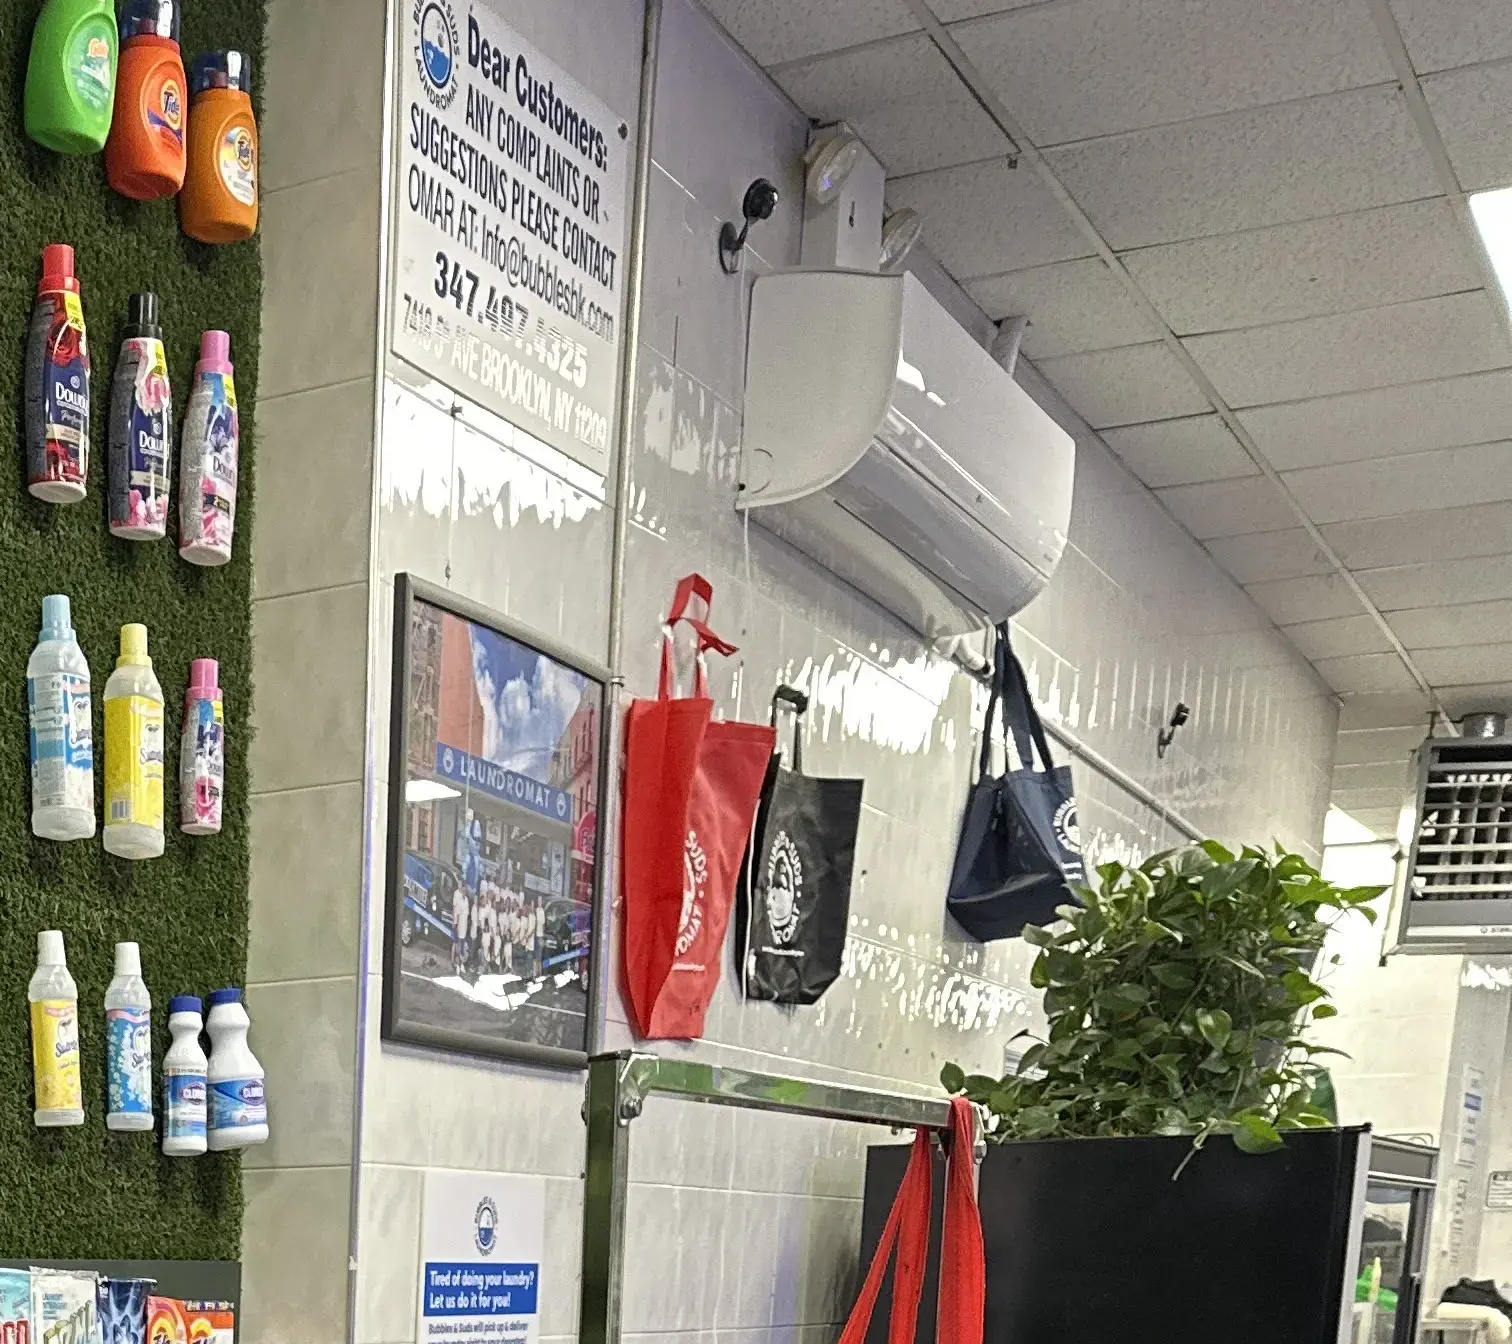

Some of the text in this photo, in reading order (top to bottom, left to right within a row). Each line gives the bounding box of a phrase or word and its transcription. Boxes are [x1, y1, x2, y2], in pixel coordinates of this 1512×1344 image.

[414, 45, 459, 110] LAUNDROMAT
[468, 13, 510, 94] Dear
[163, 90, 180, 115] Tide
[465, 83, 600, 224] ANY COMPLAINTS OR
[408, 162, 455, 238] OMAR
[457, 199, 478, 253] AT:
[410, 102, 617, 291] SUGGESTIONS PLEASE CONTACT
[554, 387, 574, 433] NY
[460, 755, 551, 809] LAUNDROMAT
[429, 1269, 535, 1291] Tired of doing your laundry?
[429, 1291, 445, 1309] Let
[445, 1295, 456, 1309] us
[457, 1292, 470, 1309] do
[470, 1292, 478, 1308] it
[478, 1291, 491, 1308] for
[428, 1322, 452, 1335] Bubbles
